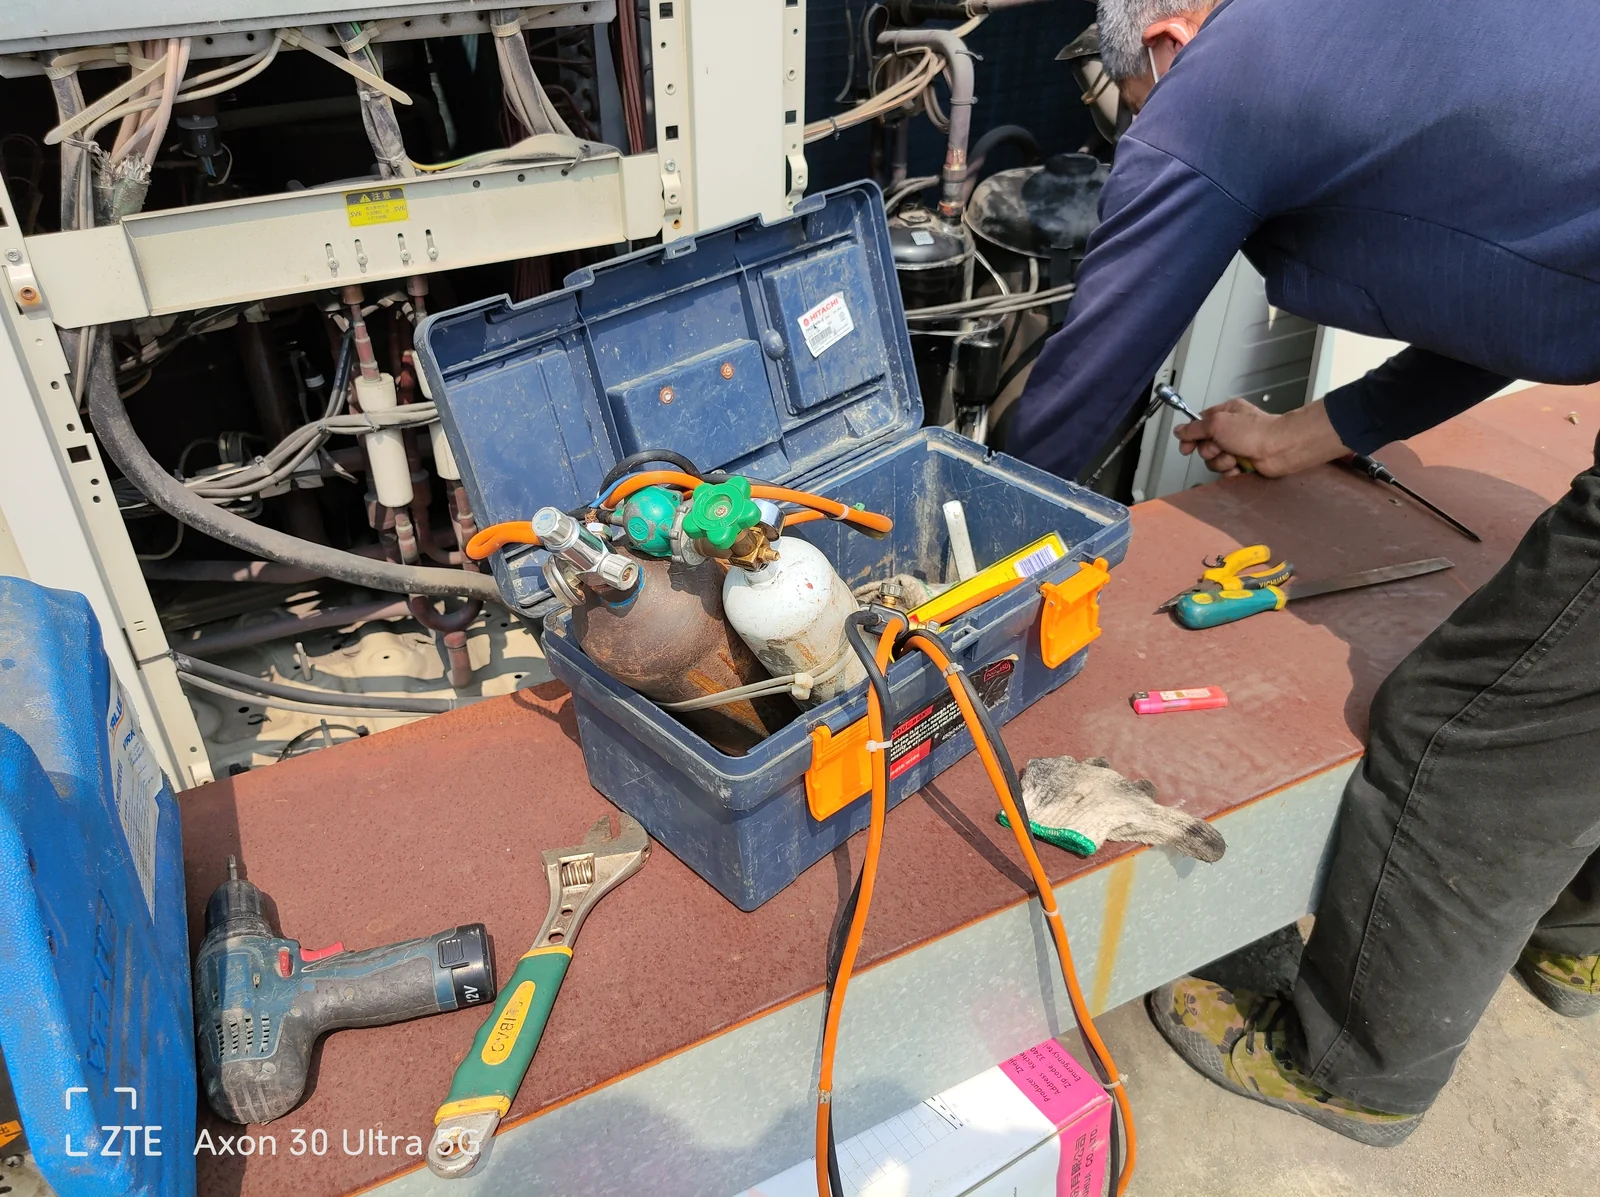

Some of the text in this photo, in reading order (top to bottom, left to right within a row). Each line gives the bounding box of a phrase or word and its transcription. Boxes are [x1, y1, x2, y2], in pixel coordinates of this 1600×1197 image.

[372, 191, 392, 201] 注意
[810, 298, 839, 322] HITACHI
[463, 985, 480, 1003] 12V
